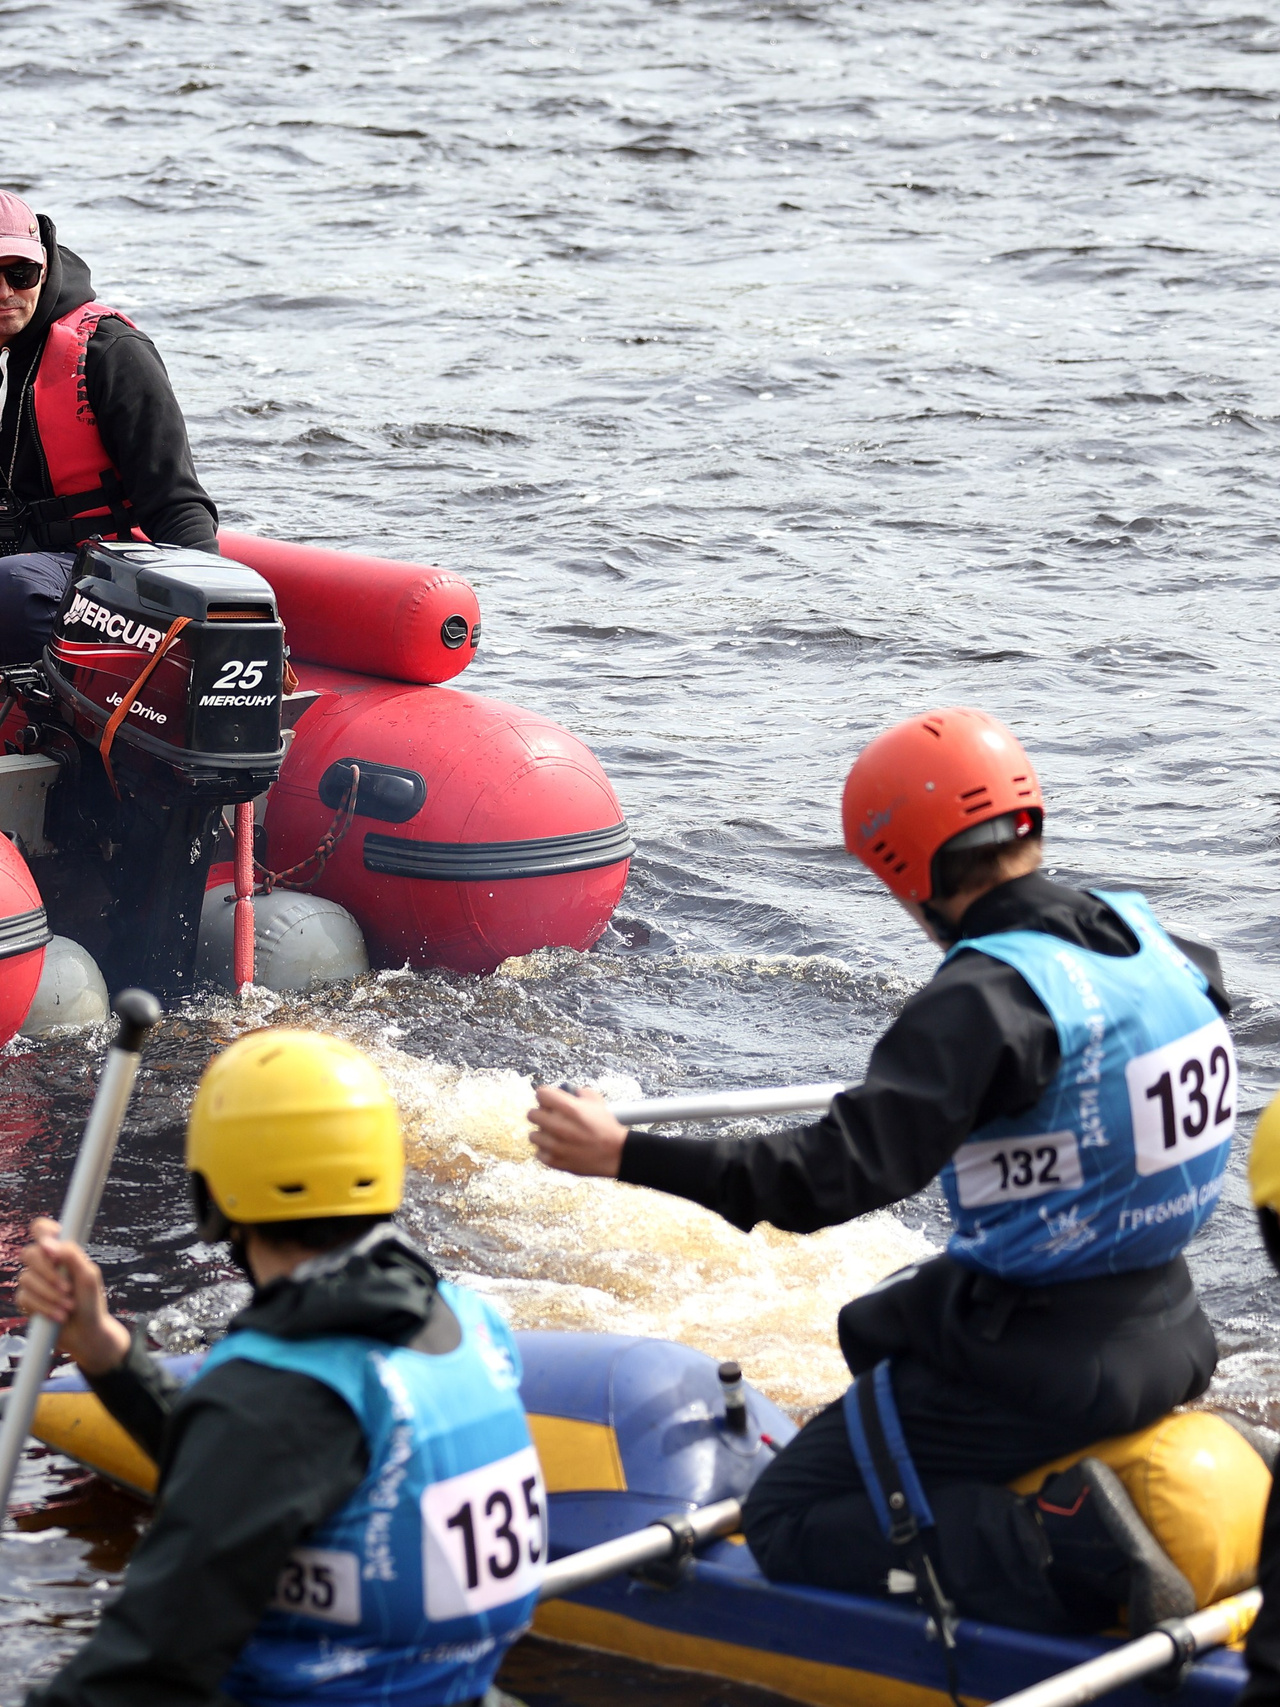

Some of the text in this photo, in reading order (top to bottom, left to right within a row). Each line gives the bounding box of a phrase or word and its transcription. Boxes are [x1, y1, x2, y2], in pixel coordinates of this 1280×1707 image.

[212, 660, 269, 690] 25
[106, 691, 168, 725] Je Drive
[199, 695, 277, 707] MERCURY
[1145, 1045, 1232, 1151] 132
[991, 1146, 1060, 1190] 132
[446, 1475, 541, 1591] 135
[279, 1559, 336, 1612] 35
